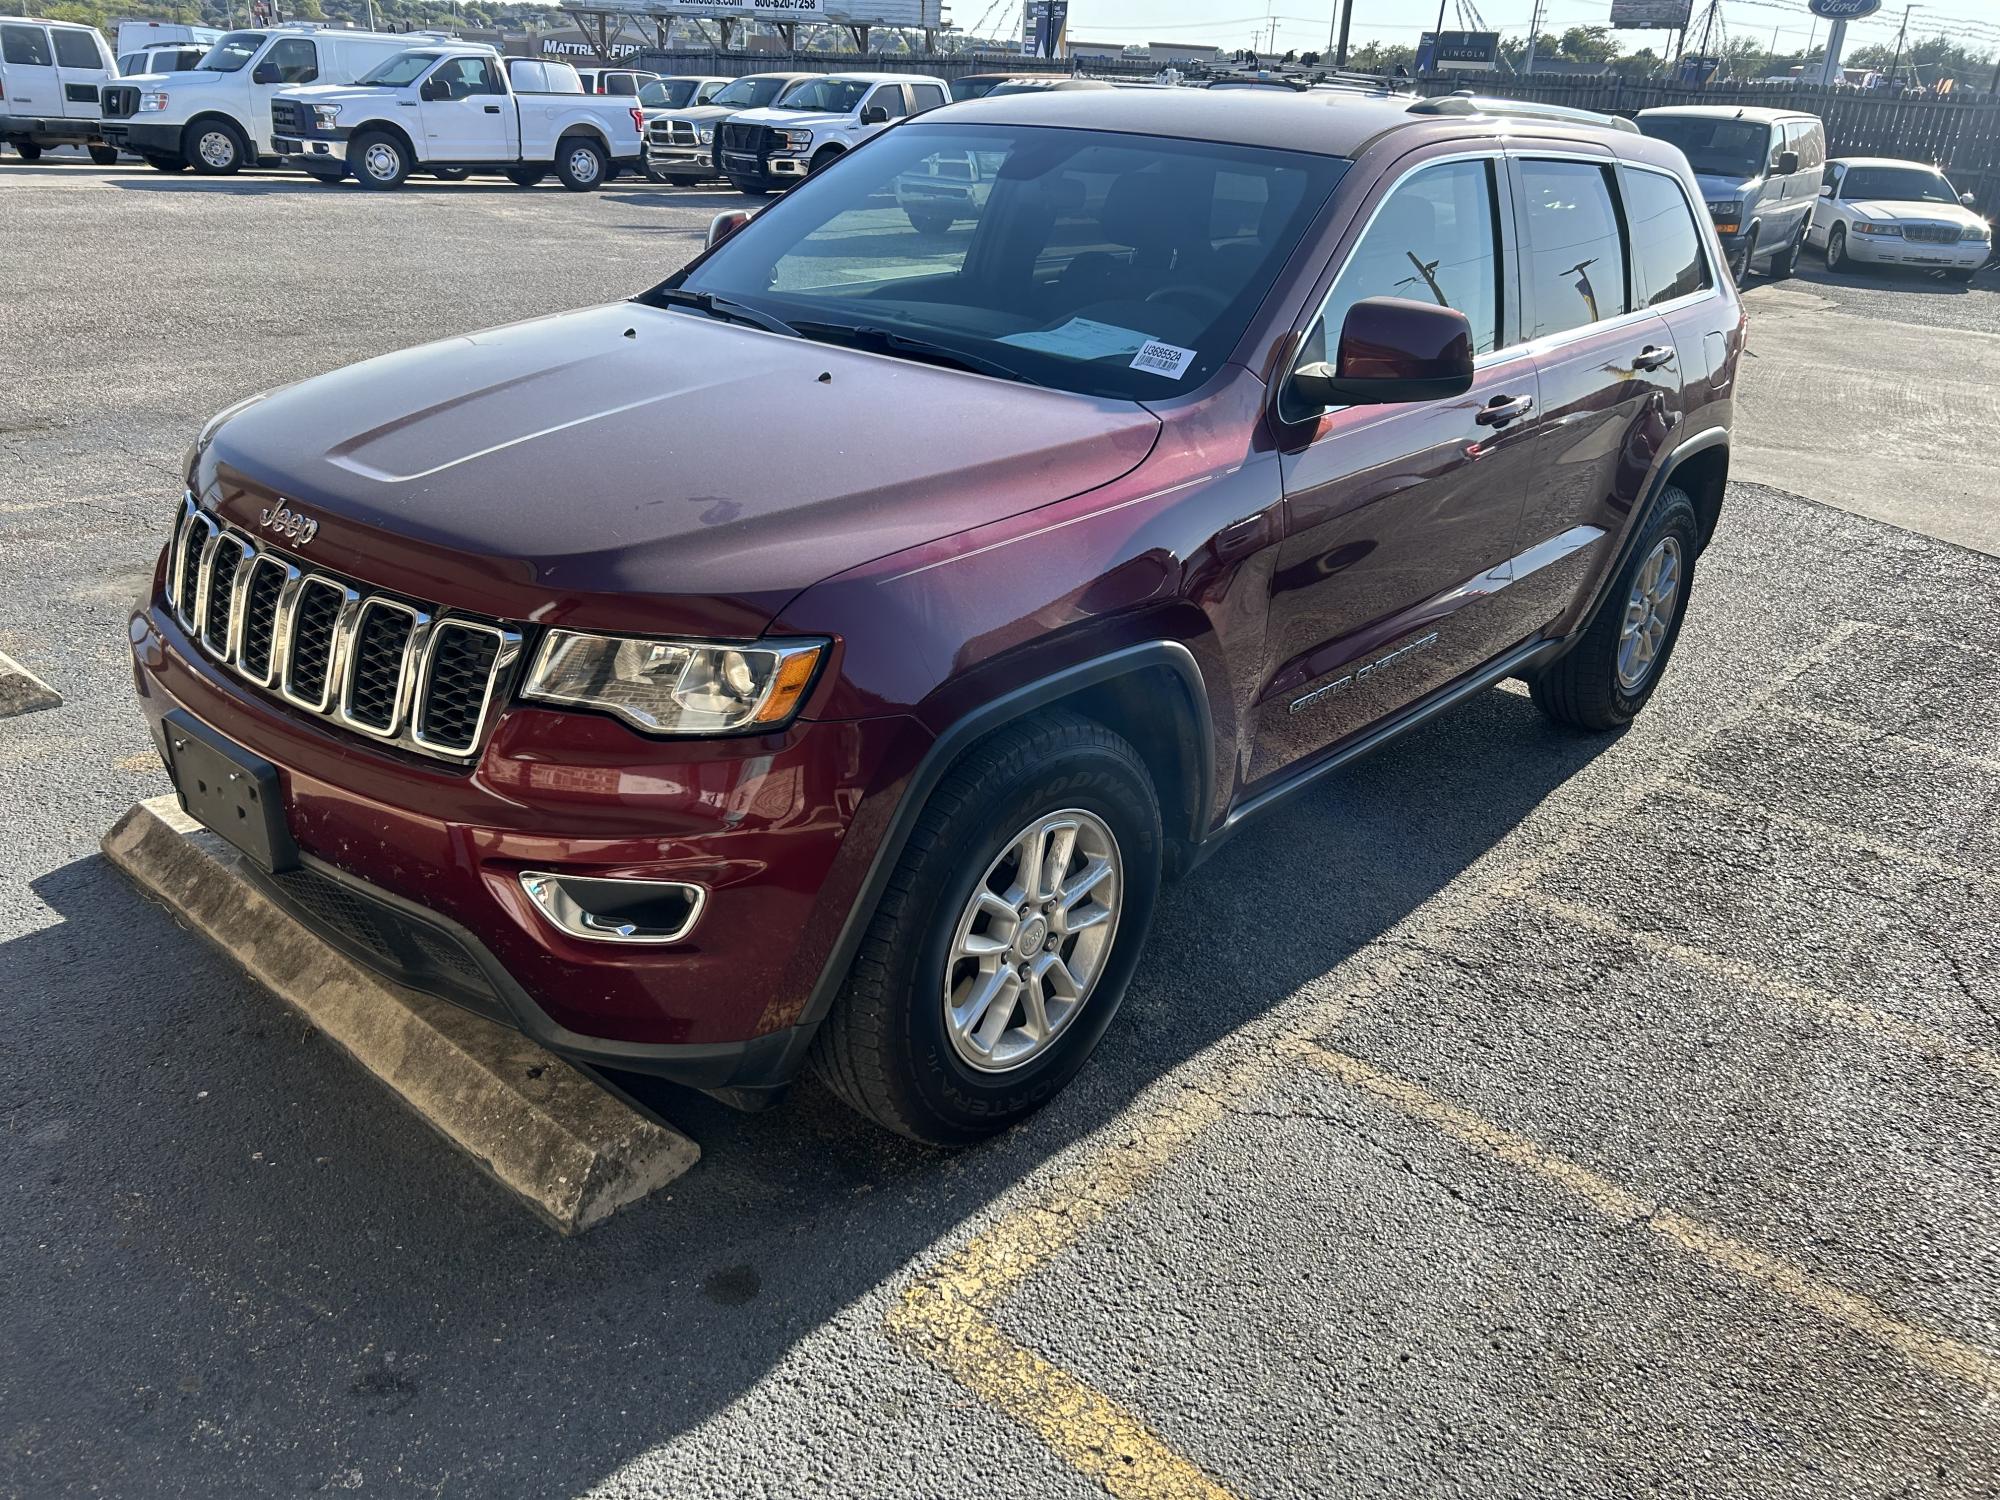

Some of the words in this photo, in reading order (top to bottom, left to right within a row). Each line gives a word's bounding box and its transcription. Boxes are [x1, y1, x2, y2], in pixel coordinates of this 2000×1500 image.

[1442, 49, 1485, 58] LINCOLN
[1143, 344, 1182, 361] U368552A
[260, 497, 318, 549] Jeep
